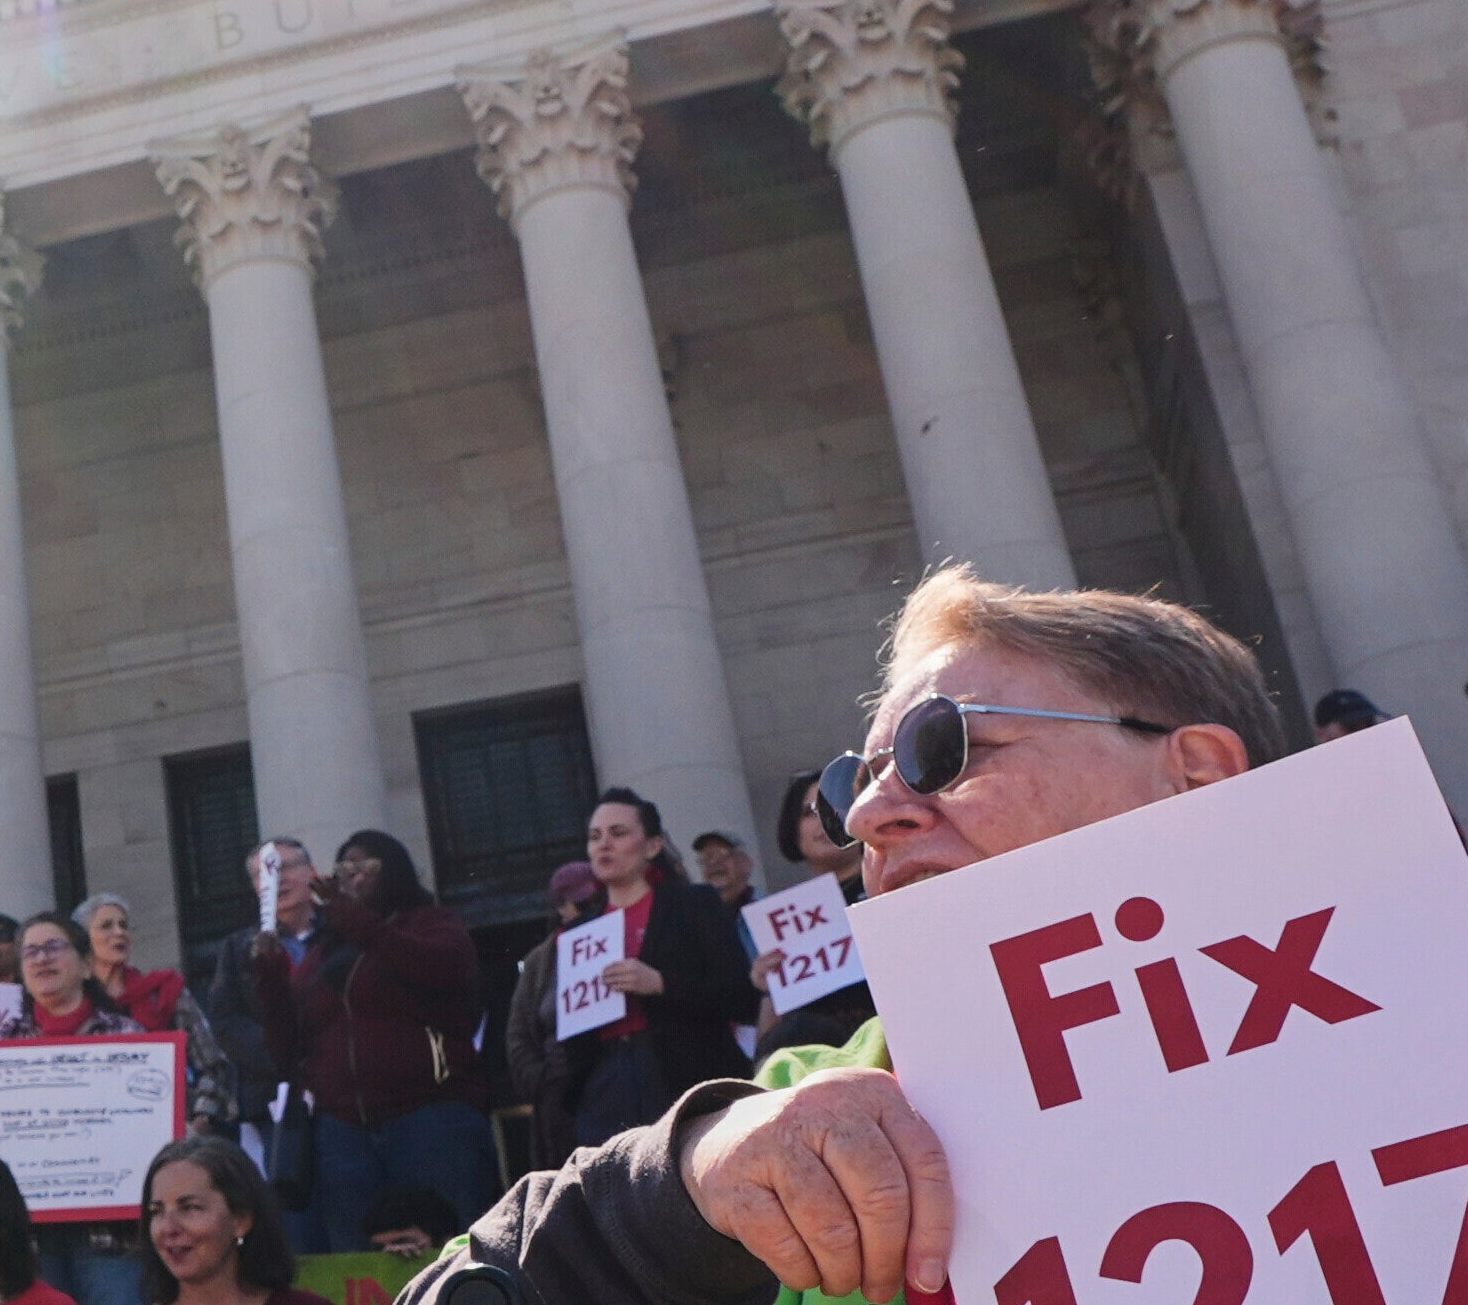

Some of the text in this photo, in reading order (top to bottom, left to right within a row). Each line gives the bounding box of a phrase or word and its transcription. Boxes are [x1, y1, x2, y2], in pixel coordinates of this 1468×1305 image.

[767, 902, 830, 942] Fix
[570, 933, 608, 967] Fix
[772, 935, 854, 989] 1217
[988, 896, 1382, 1111] Fix
